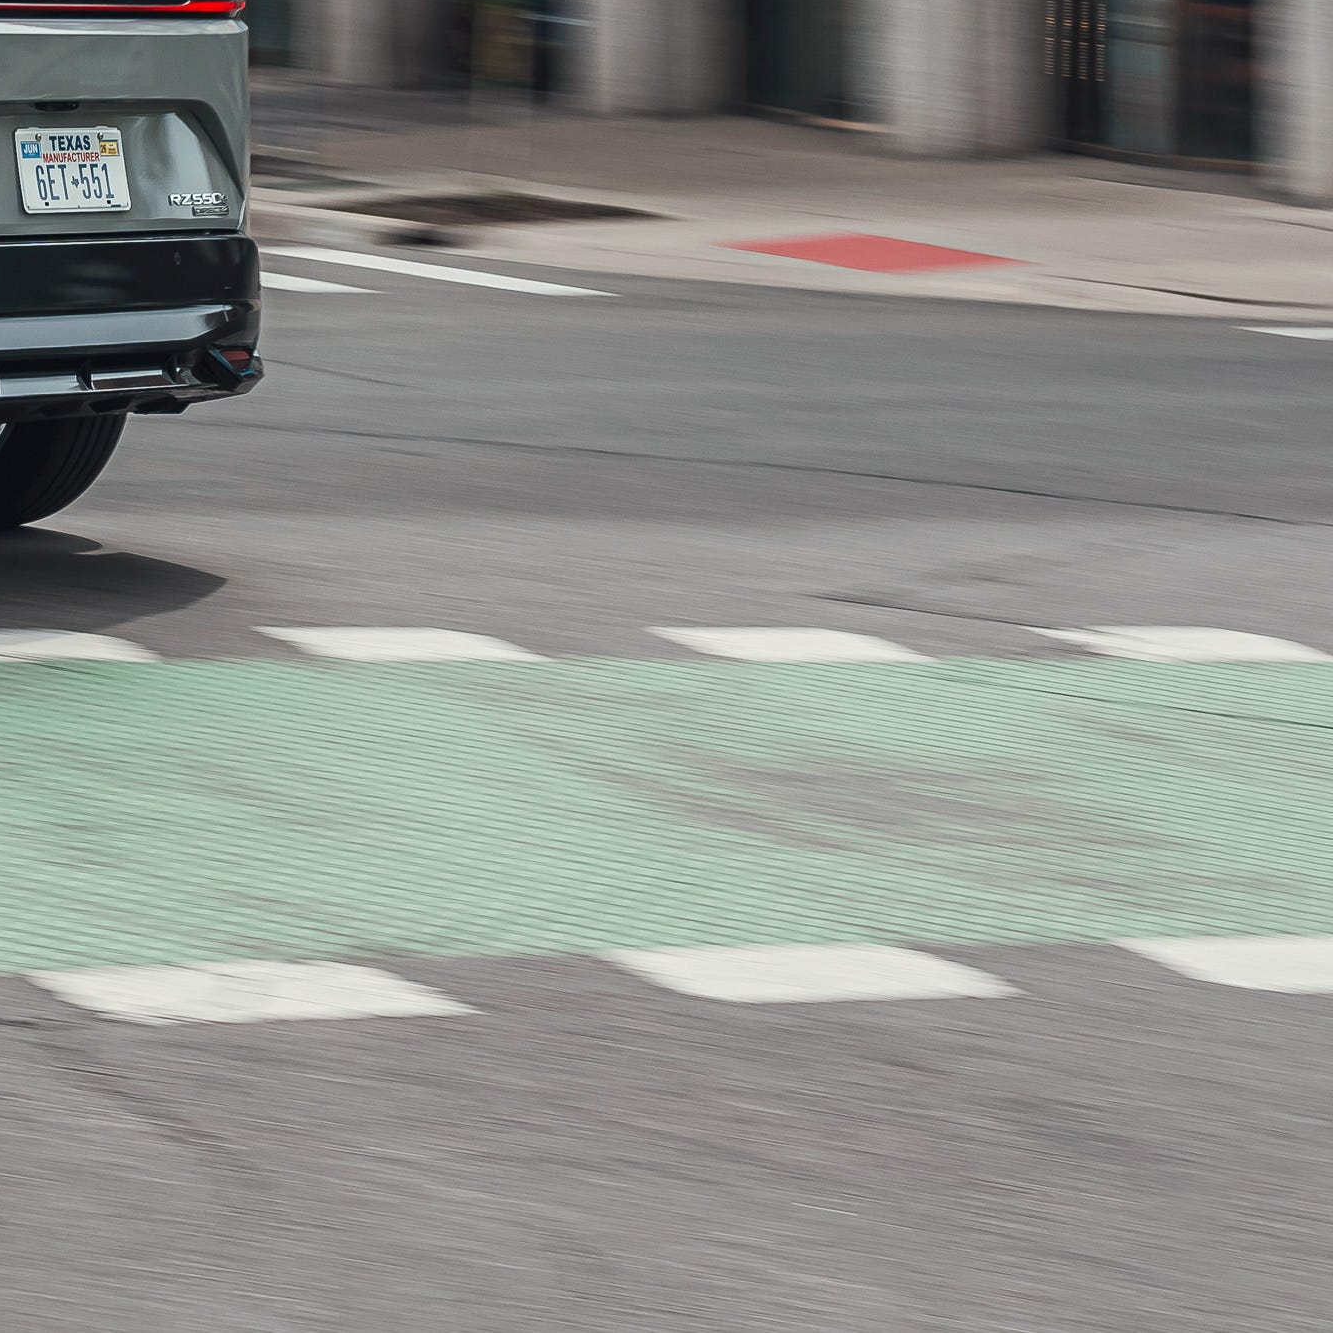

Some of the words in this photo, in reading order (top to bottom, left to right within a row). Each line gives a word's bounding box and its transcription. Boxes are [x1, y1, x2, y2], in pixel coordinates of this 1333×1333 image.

[23, 143, 39, 154] JUN
[48, 135, 91, 152] TEXAS
[42, 152, 100, 163] MANUFACTURER
